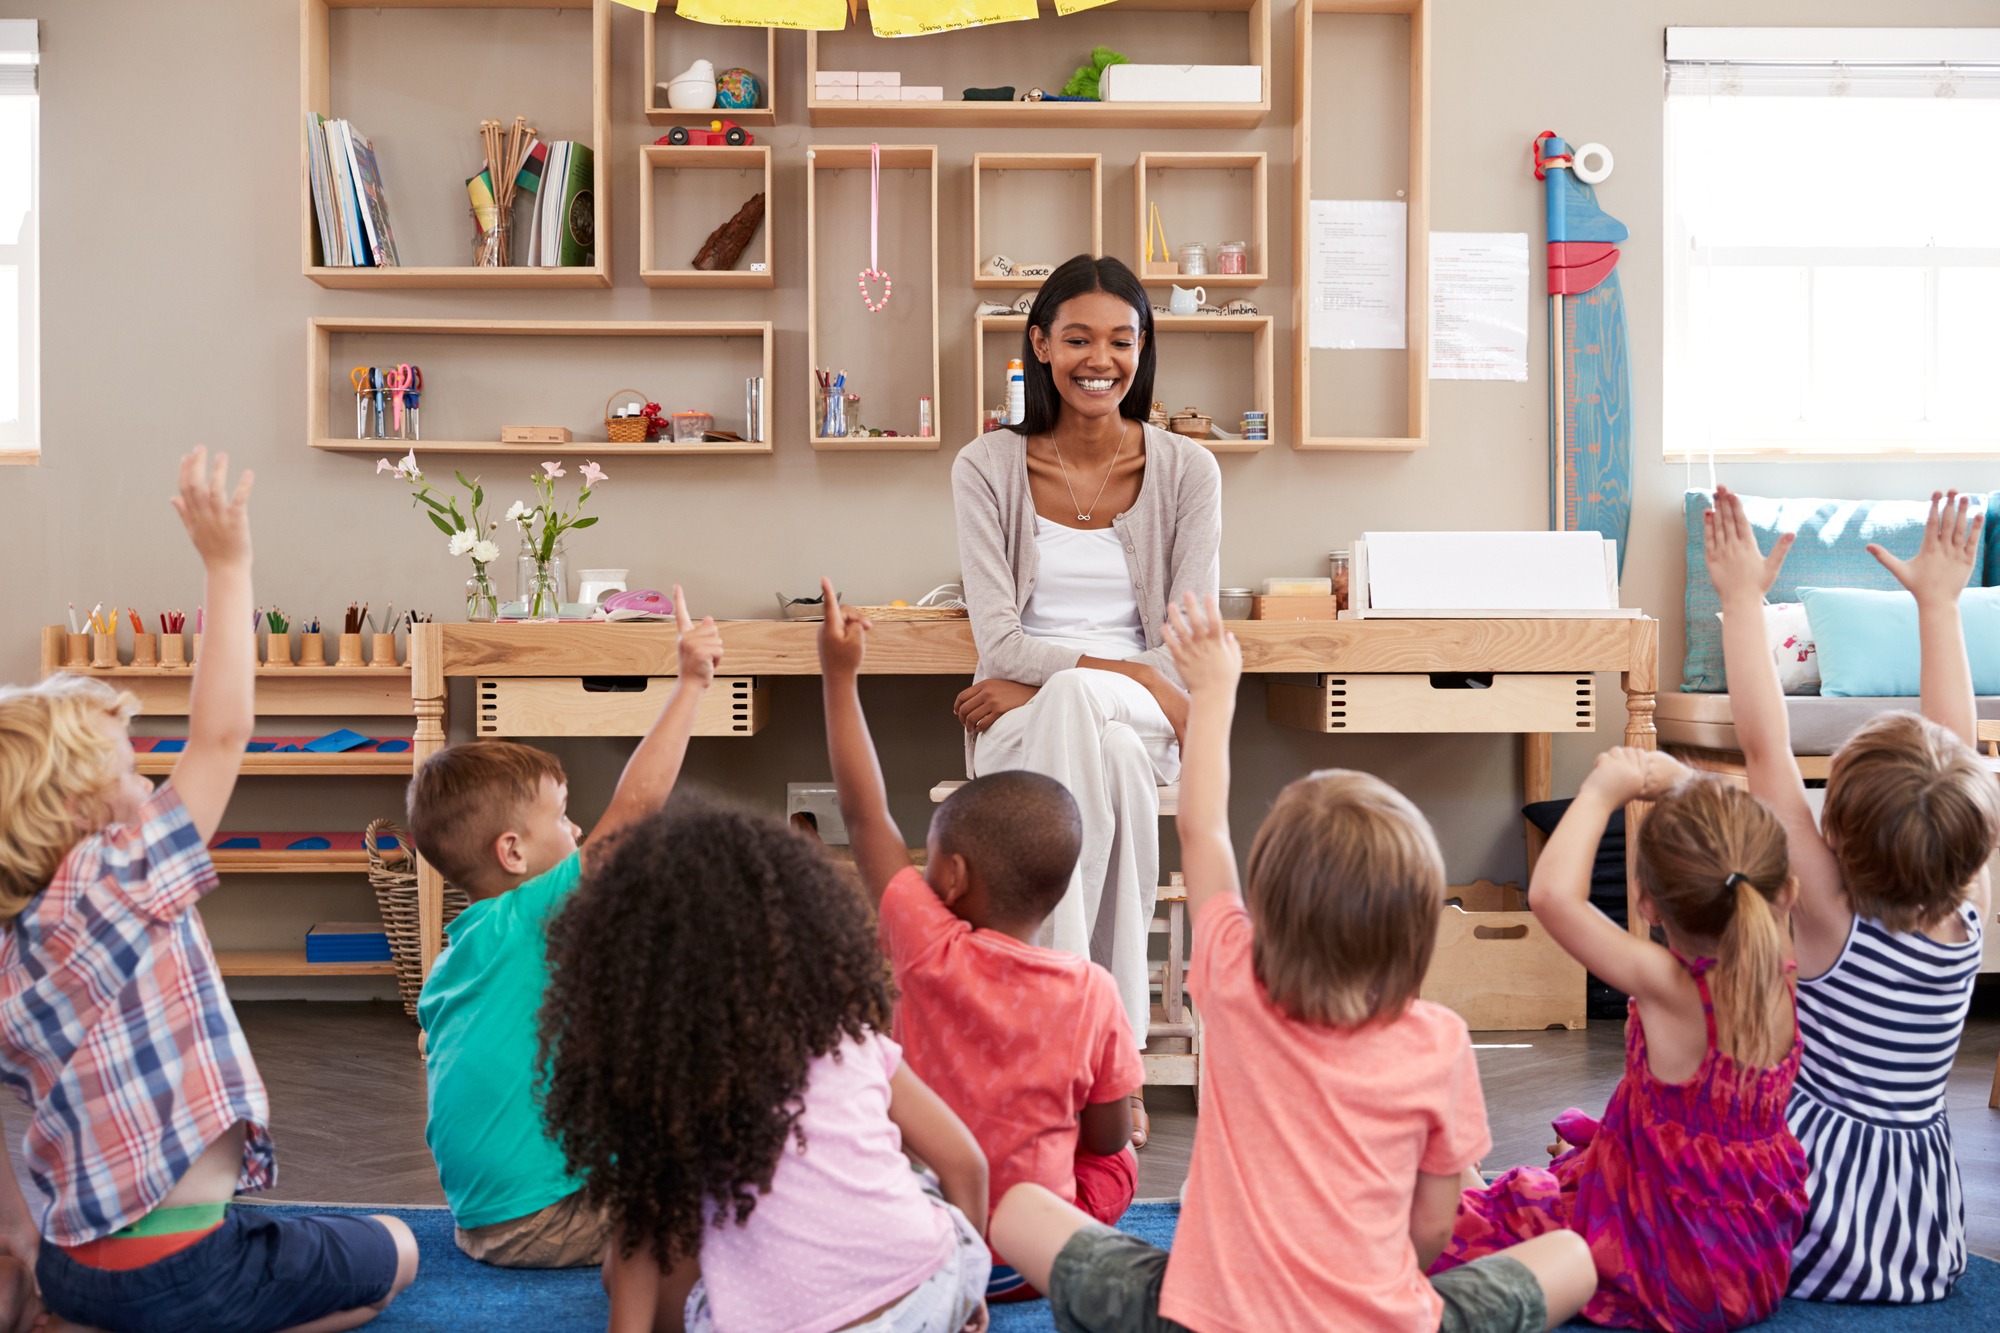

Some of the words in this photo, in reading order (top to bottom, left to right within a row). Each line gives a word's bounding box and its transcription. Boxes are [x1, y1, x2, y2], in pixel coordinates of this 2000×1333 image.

[874, 27, 902, 36] Thomas
[993, 257, 1013, 277] Joy
[1022, 268, 1049, 277] space
[1019, 299, 1032, 313] Pl
